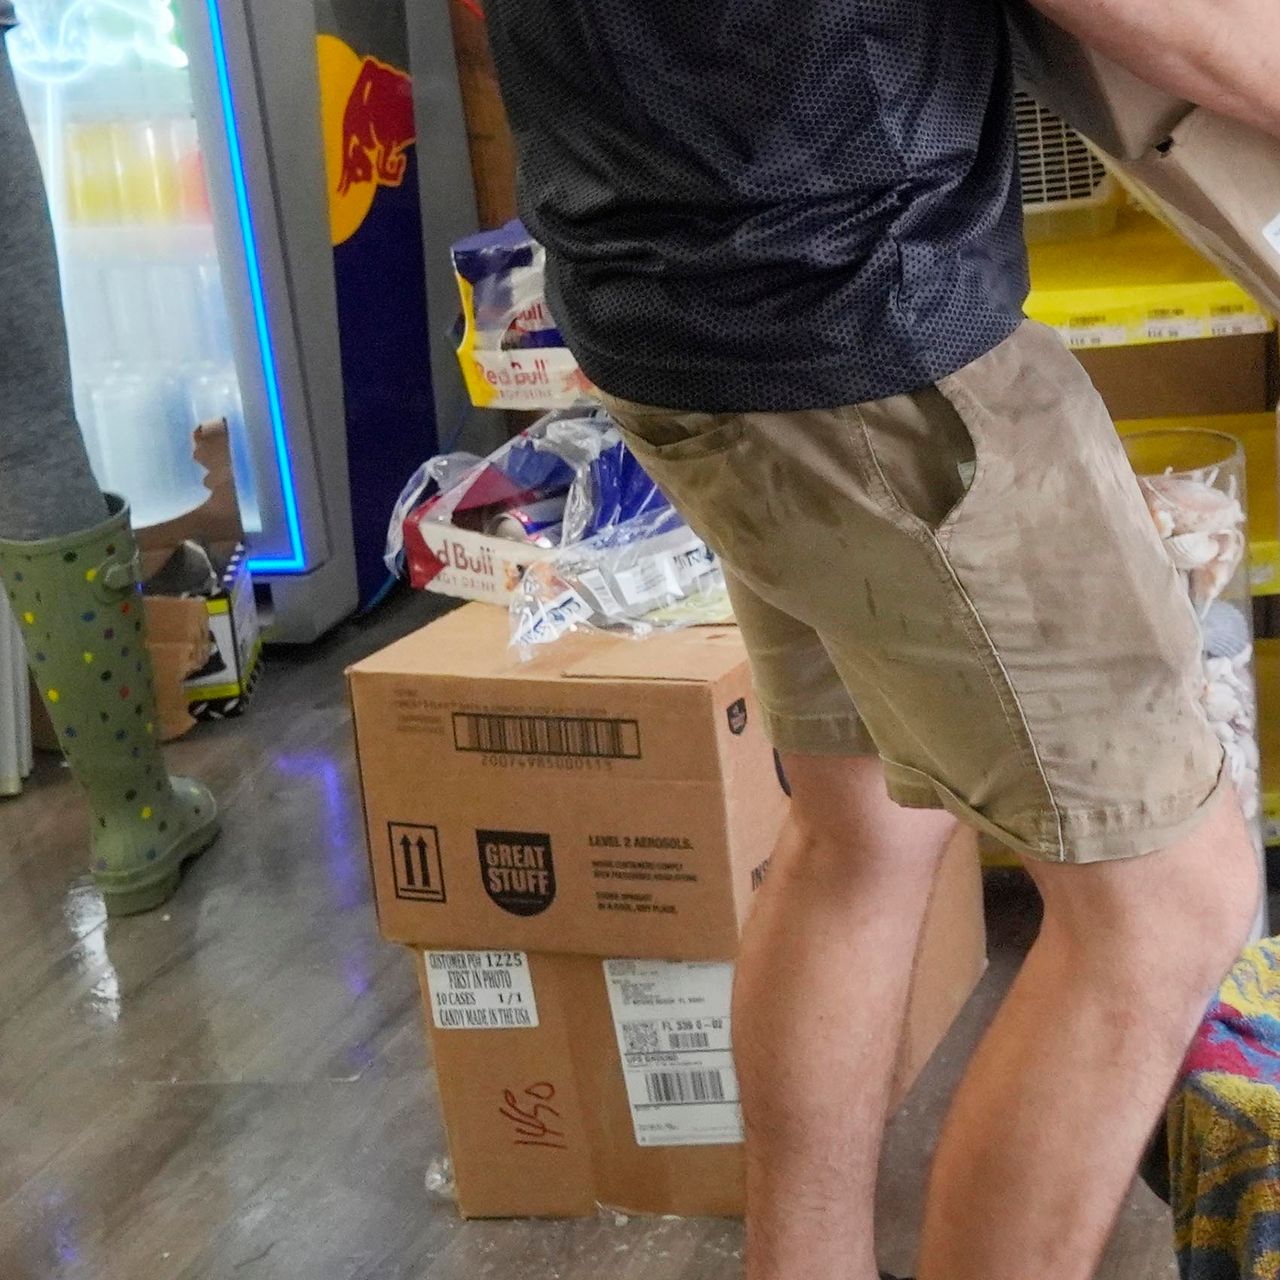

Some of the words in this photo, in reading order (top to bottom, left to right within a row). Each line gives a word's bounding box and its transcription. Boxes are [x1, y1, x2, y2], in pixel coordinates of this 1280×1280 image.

[588, 835, 621, 848] LEVEL
[623, 836, 632, 848] 2
[485, 844, 546, 870] GREAT
[488, 870, 552, 895] STUFF
[486, 953, 524, 968] 1225
[448, 971, 472, 989] FIRST
[472, 971, 483, 988] IN
[484, 970, 513, 988] PHOTO
[450, 992, 477, 1005] CASES
[439, 1009, 465, 1026] CANDY
[466, 1009, 487, 1025] MADE
[489, 1009, 499, 1025] IN
